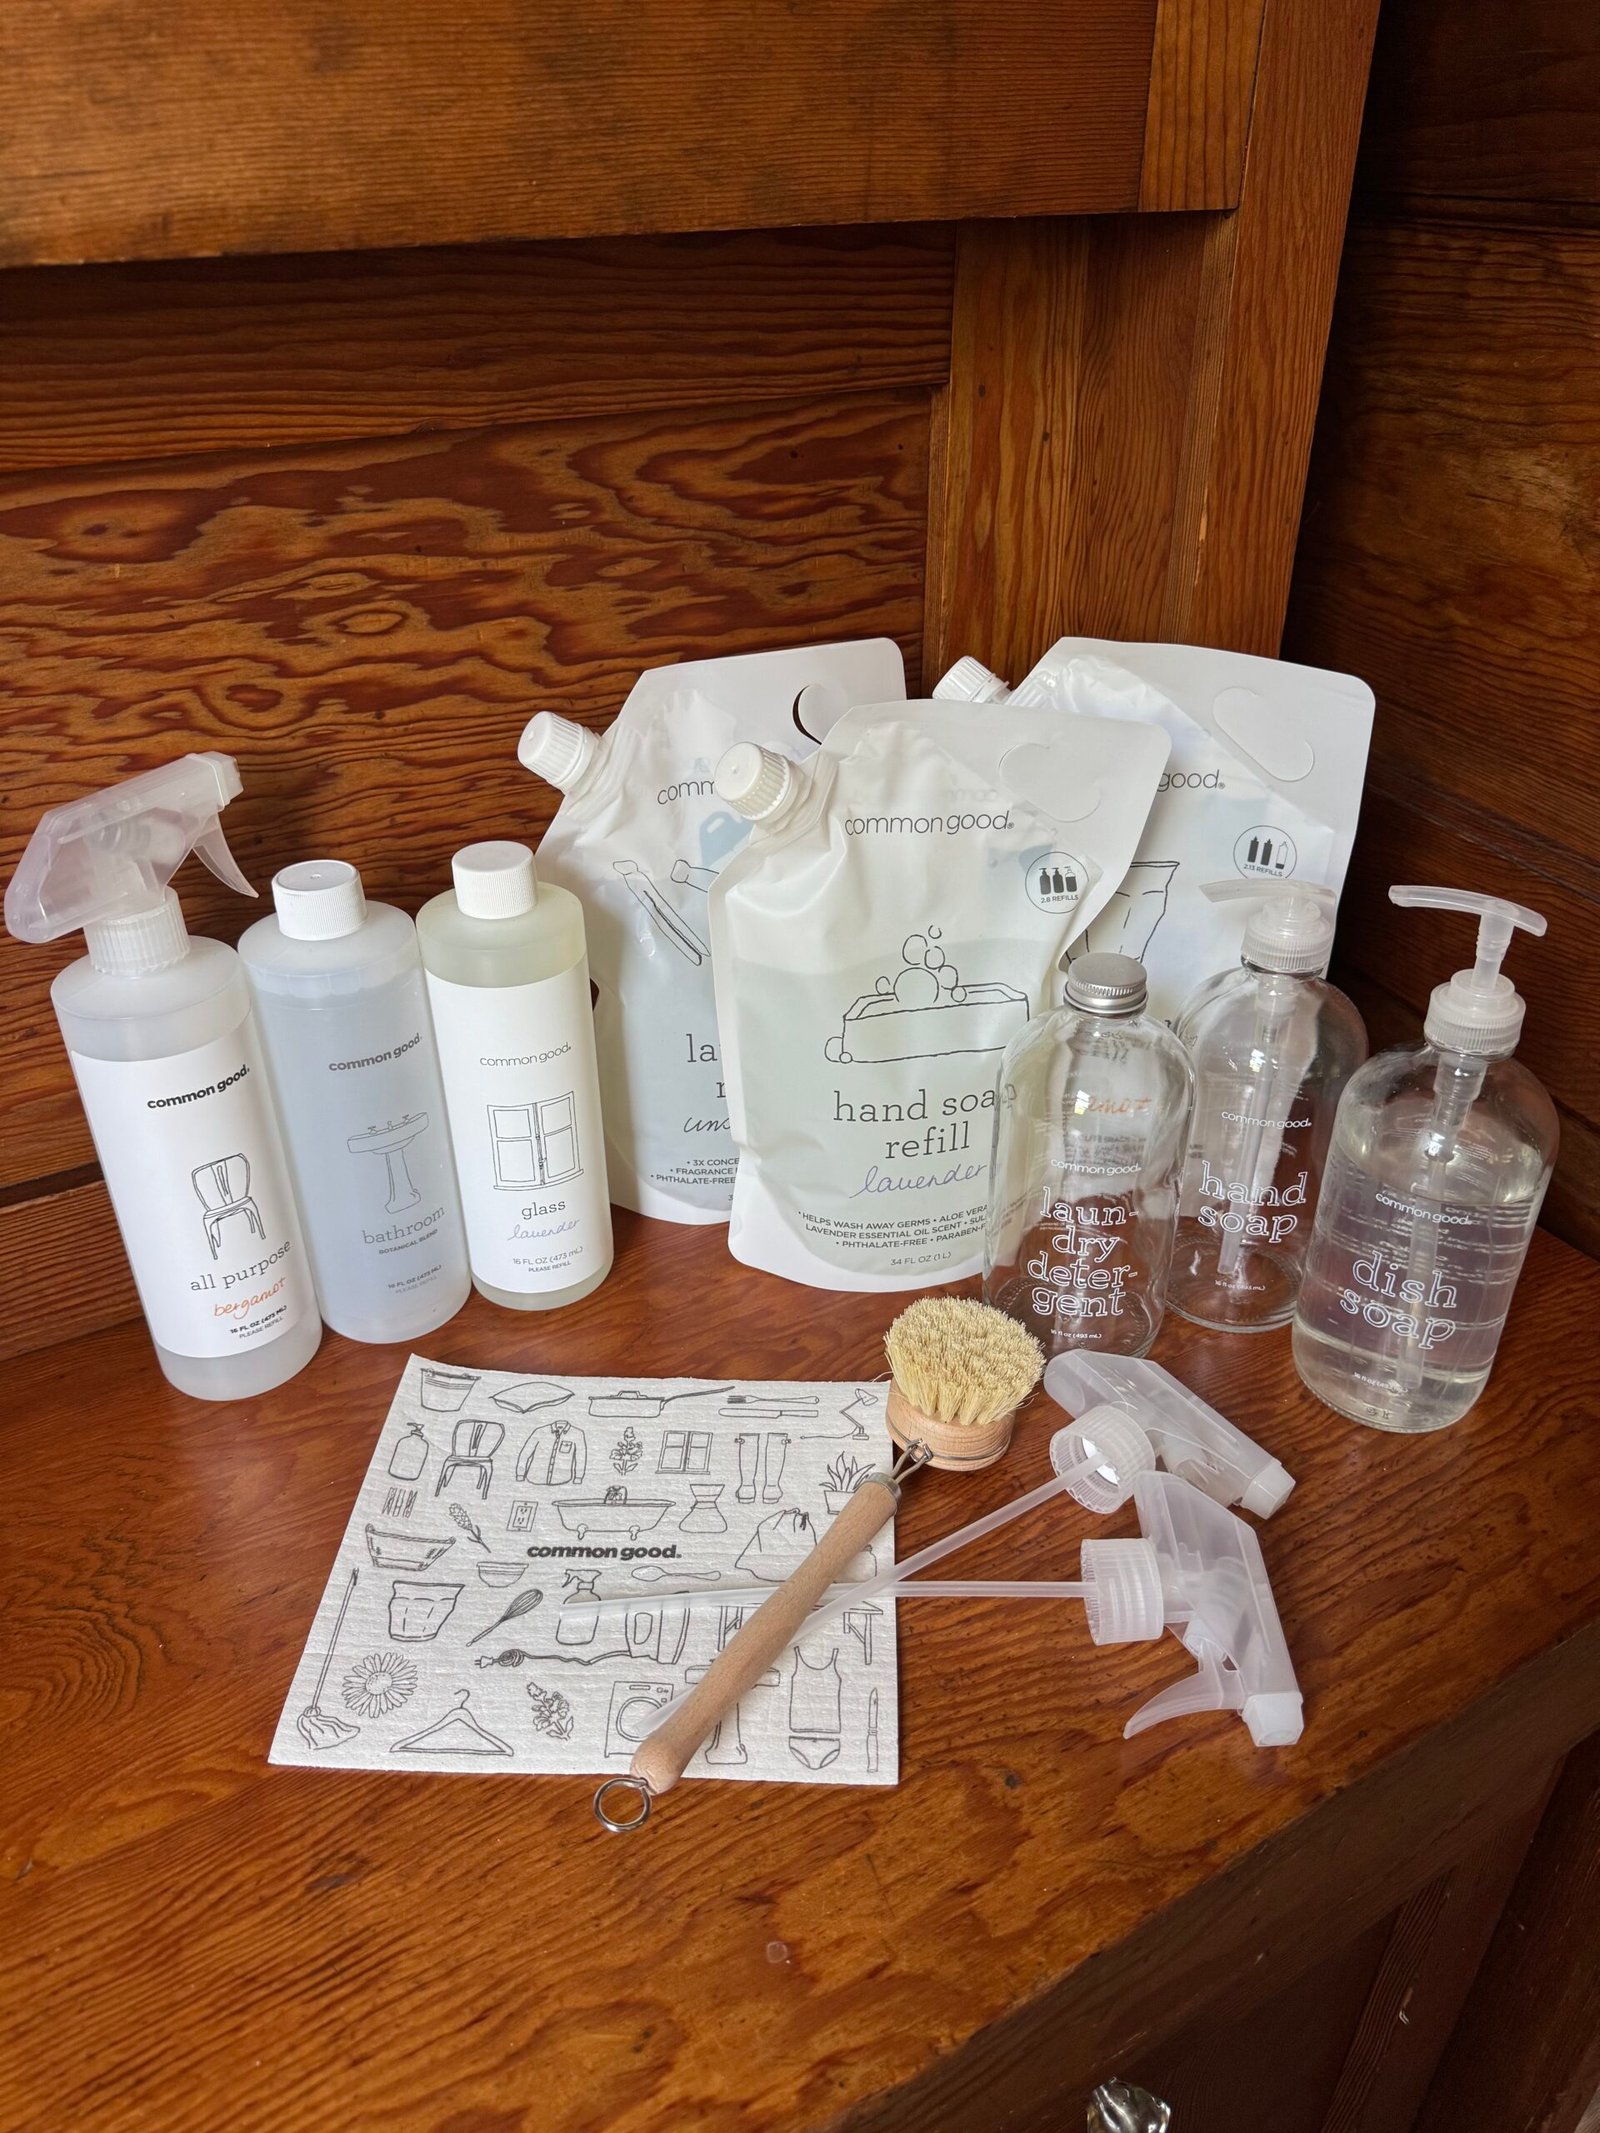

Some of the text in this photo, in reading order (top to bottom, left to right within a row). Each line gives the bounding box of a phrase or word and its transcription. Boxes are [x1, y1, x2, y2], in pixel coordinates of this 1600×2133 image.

[845, 815, 943, 836] common
[1257, 866, 1283, 877] REFILLS
[1041, 894, 1079, 904] 2.8 REFILLS
[329, 1051, 392, 1071] common
[480, 1055, 538, 1067] common
[147, 1086, 216, 1109] common
[833, 1089, 928, 1122] hand
[1221, 1111, 1276, 1127] common
[885, 1120, 970, 1159] refill
[676, 1167, 733, 1176] FRAGRANCE
[692, 1159, 705, 1167] 3X
[1050, 1159, 1105, 1174] common
[656, 1174, 736, 1185] PHTHALATE-FREE
[849, 1163, 987, 1198] lavender
[1199, 1160, 1308, 1207] hand
[521, 1200, 566, 1220] glass
[1040, 1186, 1139, 1225] laun-
[1375, 1193, 1431, 1220] common
[362, 1207, 445, 1244] bathroom
[507, 1219, 580, 1241] lavender
[802, 1212, 831, 1226] HELPS
[833, 1221, 863, 1230] WASH
[866, 1222, 895, 1230] AWAY
[897, 1218, 931, 1229] GERMS
[939, 1211, 964, 1223] ALOE
[805, 1223, 857, 1239] LAVENDER
[858, 1231, 911, 1240] ESSENTIAL
[914, 1228, 930, 1236] OIL
[932, 1221, 962, 1234] SCENT
[1198, 1206, 1298, 1243] soap
[379, 1229, 438, 1254] BOTANICAL BLEND
[842, 1237, 928, 1249] PHTHALATE-FREE
[1052, 1225, 1120, 1262] dry
[190, 1241, 291, 1291] all purpose
[528, 1261, 572, 1273] PLEASE REFILL
[534, 1256, 548, 1265] OZ
[549, 1251, 567, 1263] (473
[890, 1258, 902, 1266] 34
[918, 1255, 932, 1263] OZ
[1027, 1251, 1138, 1289] deter-
[1353, 1250, 1457, 1308] dish
[214, 1276, 286, 1319] bergamot
[1032, 1287, 1126, 1317] gent
[239, 1316, 283, 1338] PLEASE REFILL
[250, 1320, 260, 1328] OZ
[1340, 1289, 1456, 1350] soap
[527, 1546, 618, 1558] common
